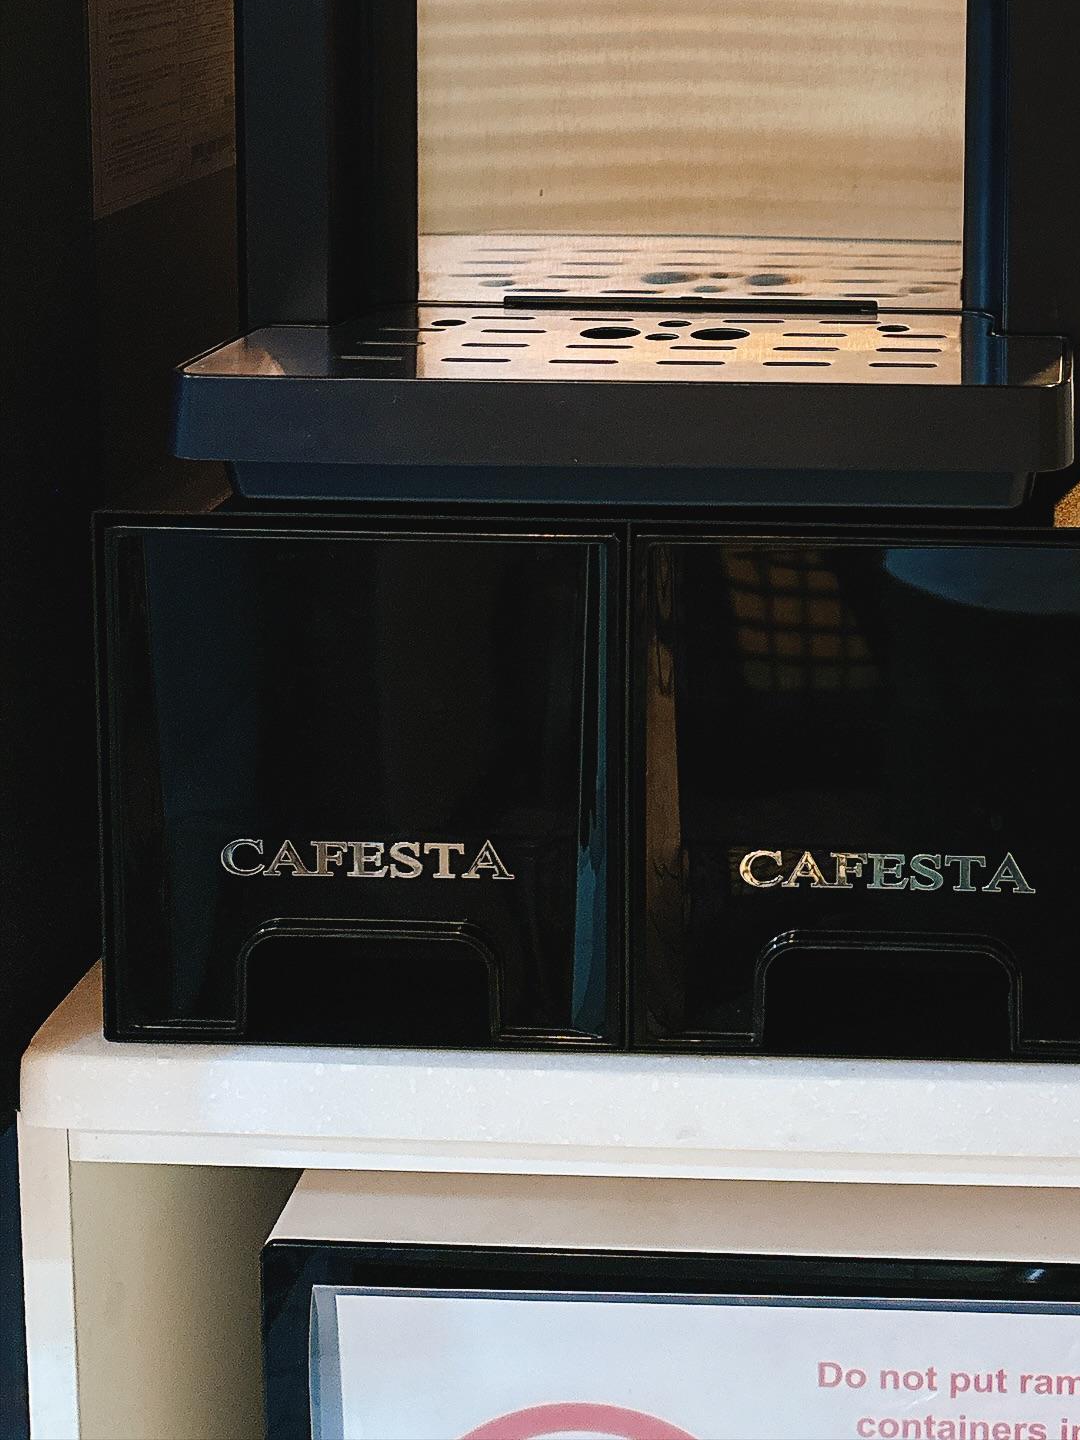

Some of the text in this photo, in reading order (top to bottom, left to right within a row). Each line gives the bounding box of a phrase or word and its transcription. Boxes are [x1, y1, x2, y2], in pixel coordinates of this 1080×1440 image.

[220, 838, 515, 881] CAFESTA
[739, 849, 1037, 895] CAFESTA
[817, 1361, 867, 1389] Do
[879, 1366, 937, 1392] not
[949, 1368, 1008, 1398] put
[856, 1414, 1048, 1440] containers
